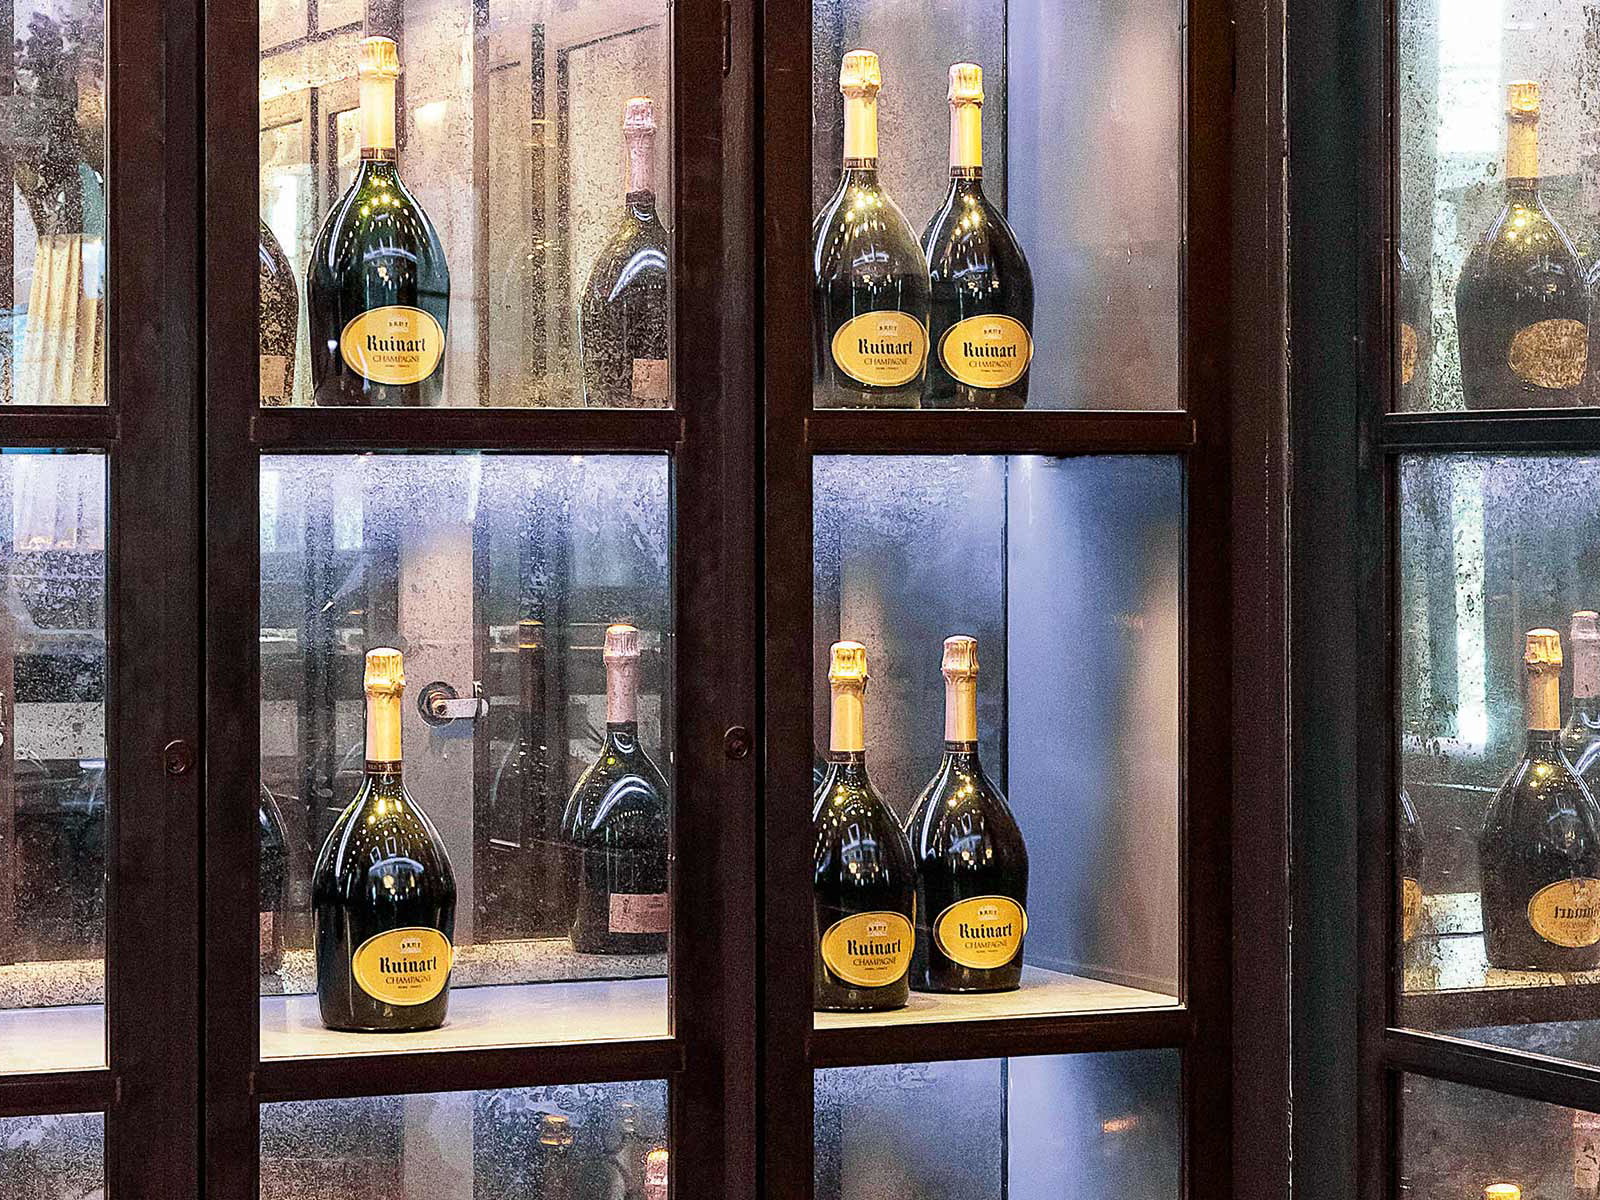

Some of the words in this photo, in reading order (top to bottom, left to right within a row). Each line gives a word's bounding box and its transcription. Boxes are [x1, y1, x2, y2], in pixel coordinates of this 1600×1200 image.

[367, 335, 425, 352] Ruinart
[858, 338, 912, 355] Ruinart
[963, 342, 1016, 358] Ruinart
[959, 923, 1012, 939] Ruinart
[847, 939, 901, 956] Ruinart
[379, 956, 437, 973] Ruinart
